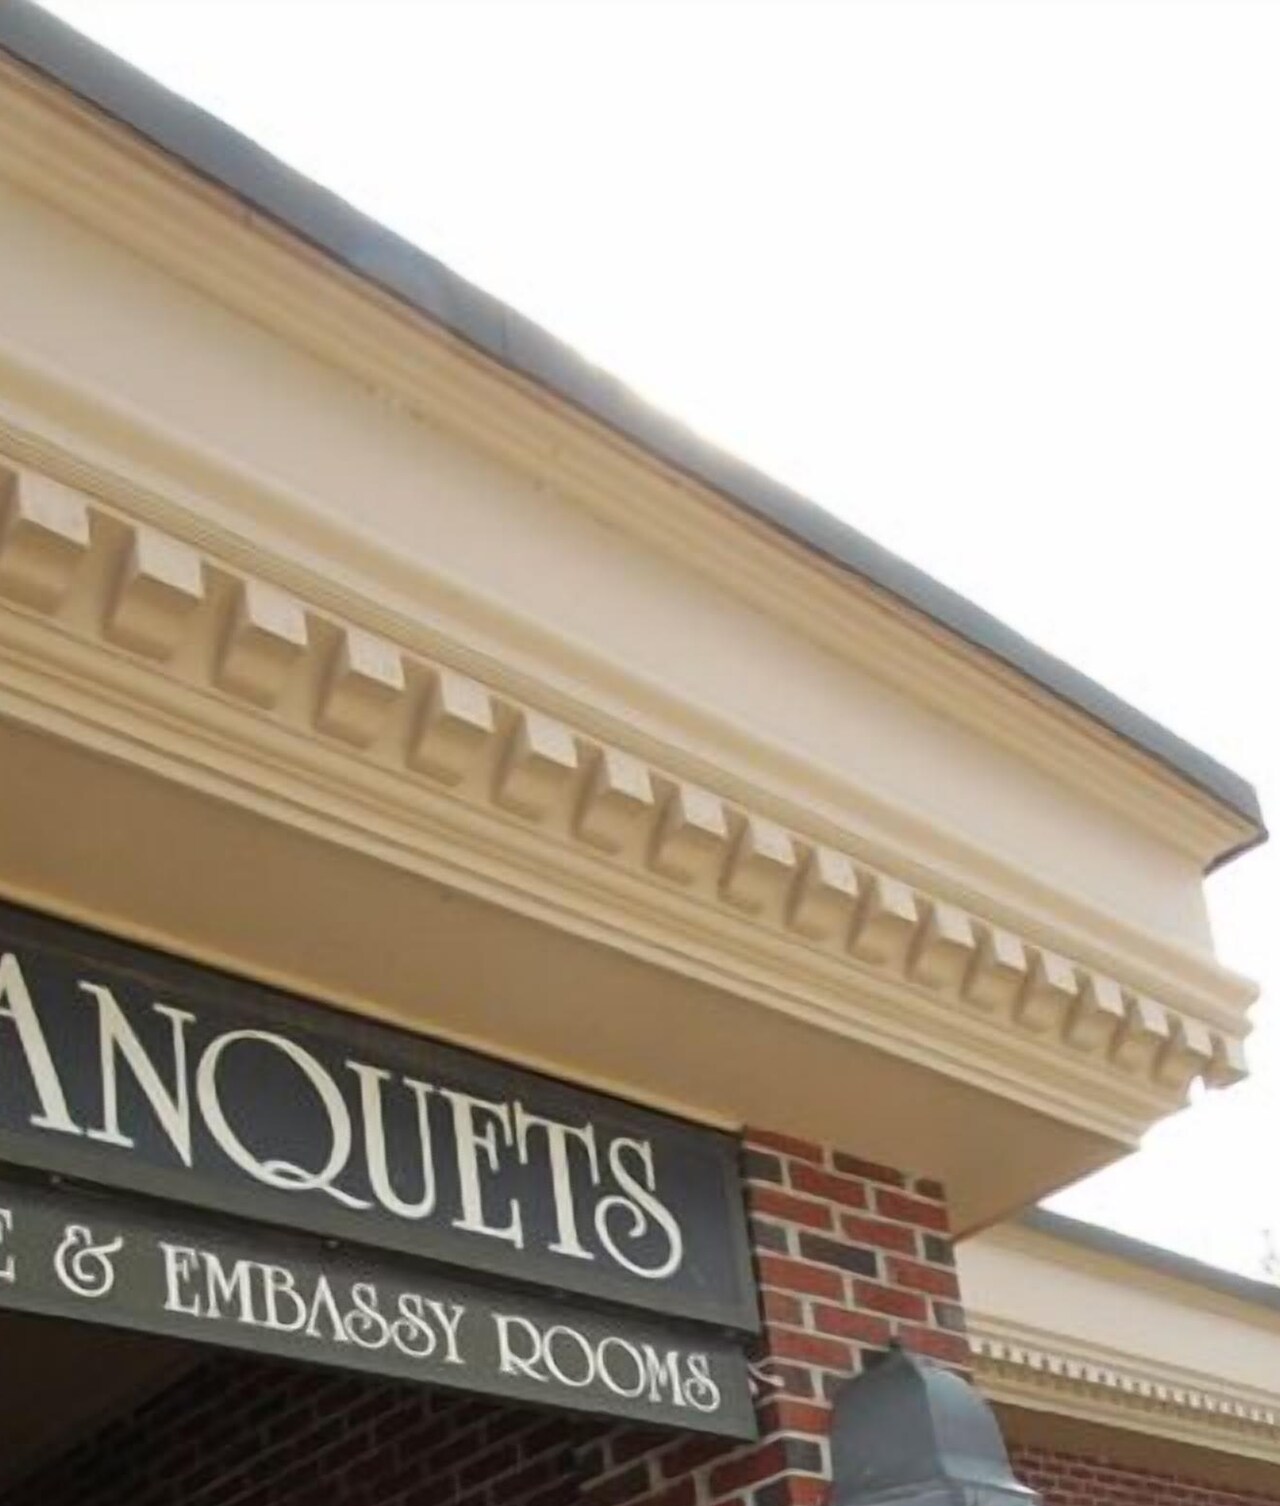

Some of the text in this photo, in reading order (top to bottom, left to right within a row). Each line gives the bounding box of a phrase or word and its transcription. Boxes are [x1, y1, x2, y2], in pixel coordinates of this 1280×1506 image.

[53, 1223, 125, 1299] &
[158, 1240, 467, 1367] EMBASSY
[490, 1311, 722, 1414] ROOMS
